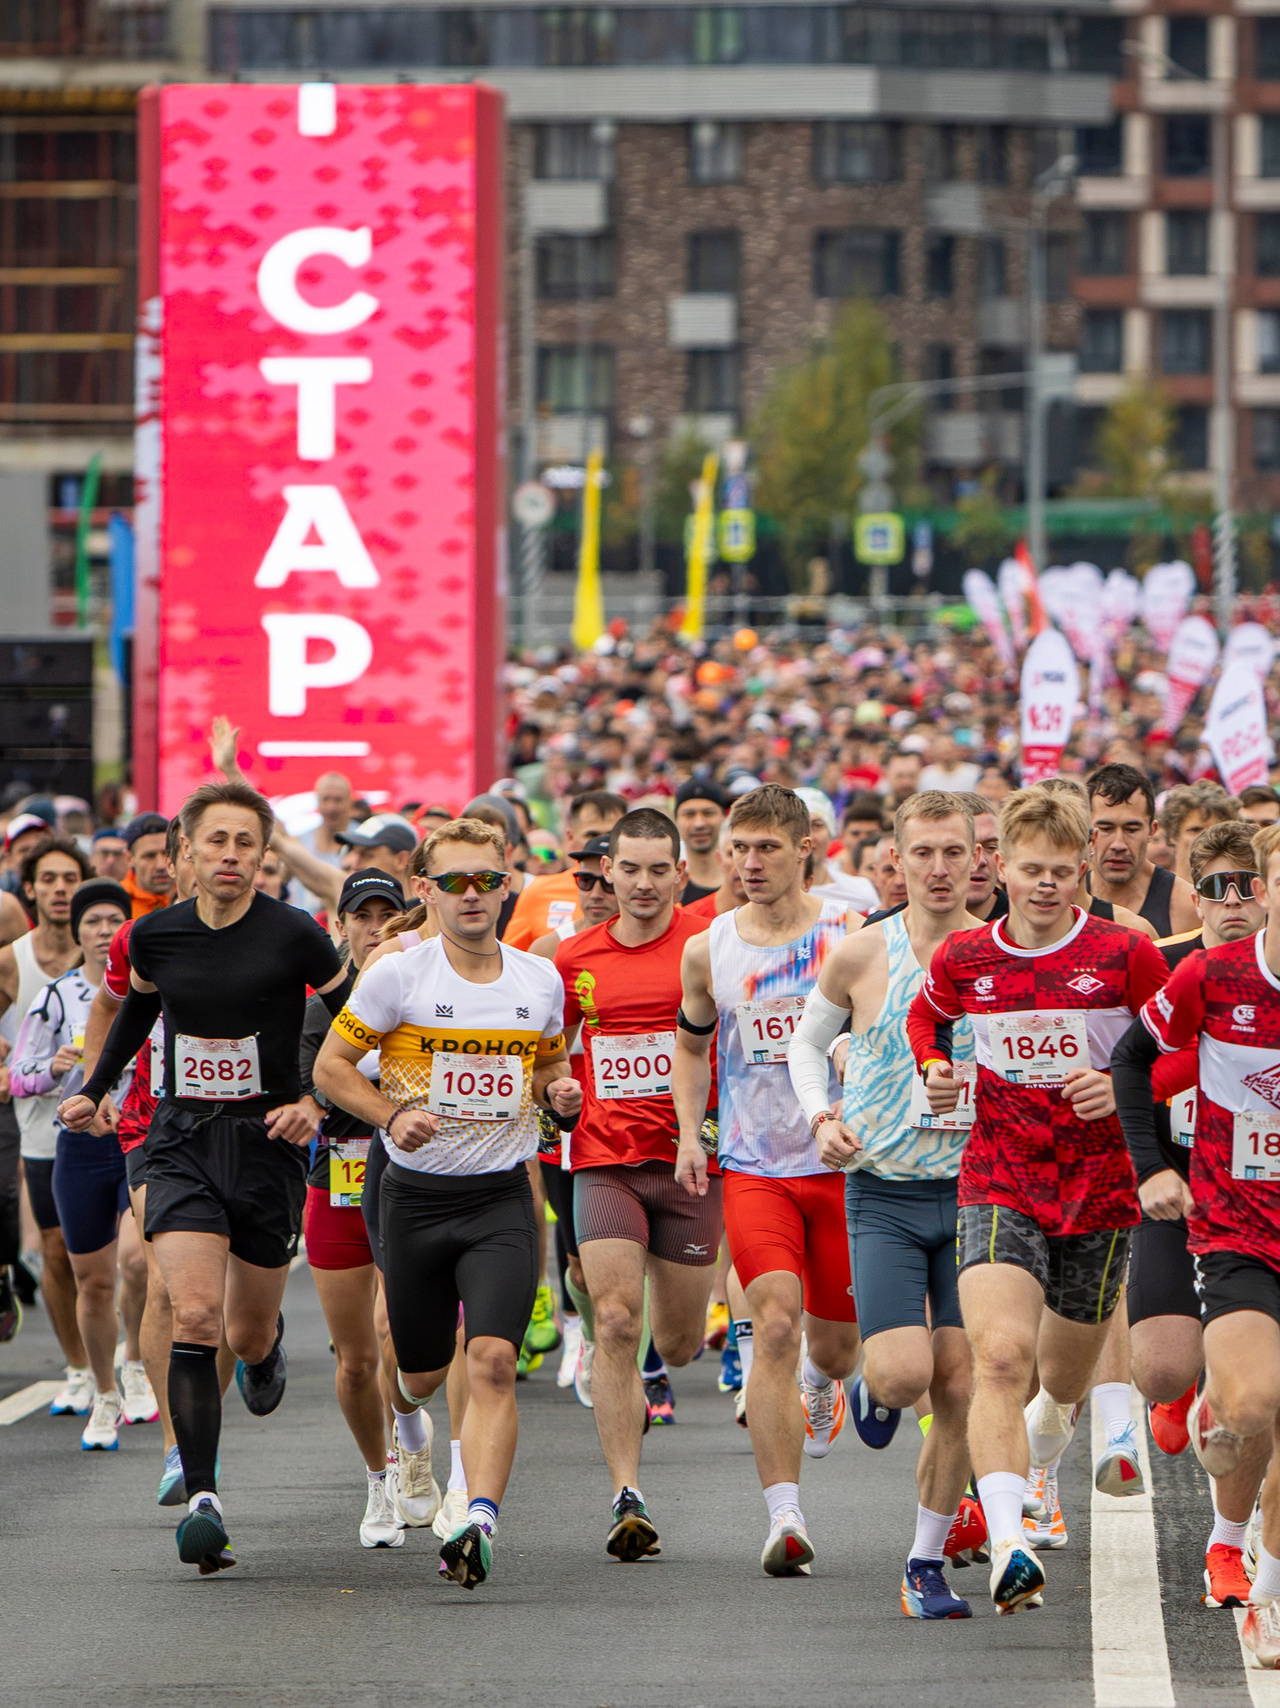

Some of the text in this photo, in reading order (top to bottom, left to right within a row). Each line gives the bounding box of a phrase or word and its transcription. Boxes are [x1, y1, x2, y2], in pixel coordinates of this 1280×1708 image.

[1002, 1033, 1079, 1060] 1846
[183, 1056, 253, 1081] 2682
[600, 1053, 672, 1080] 2900
[443, 1071, 514, 1098] 1036
